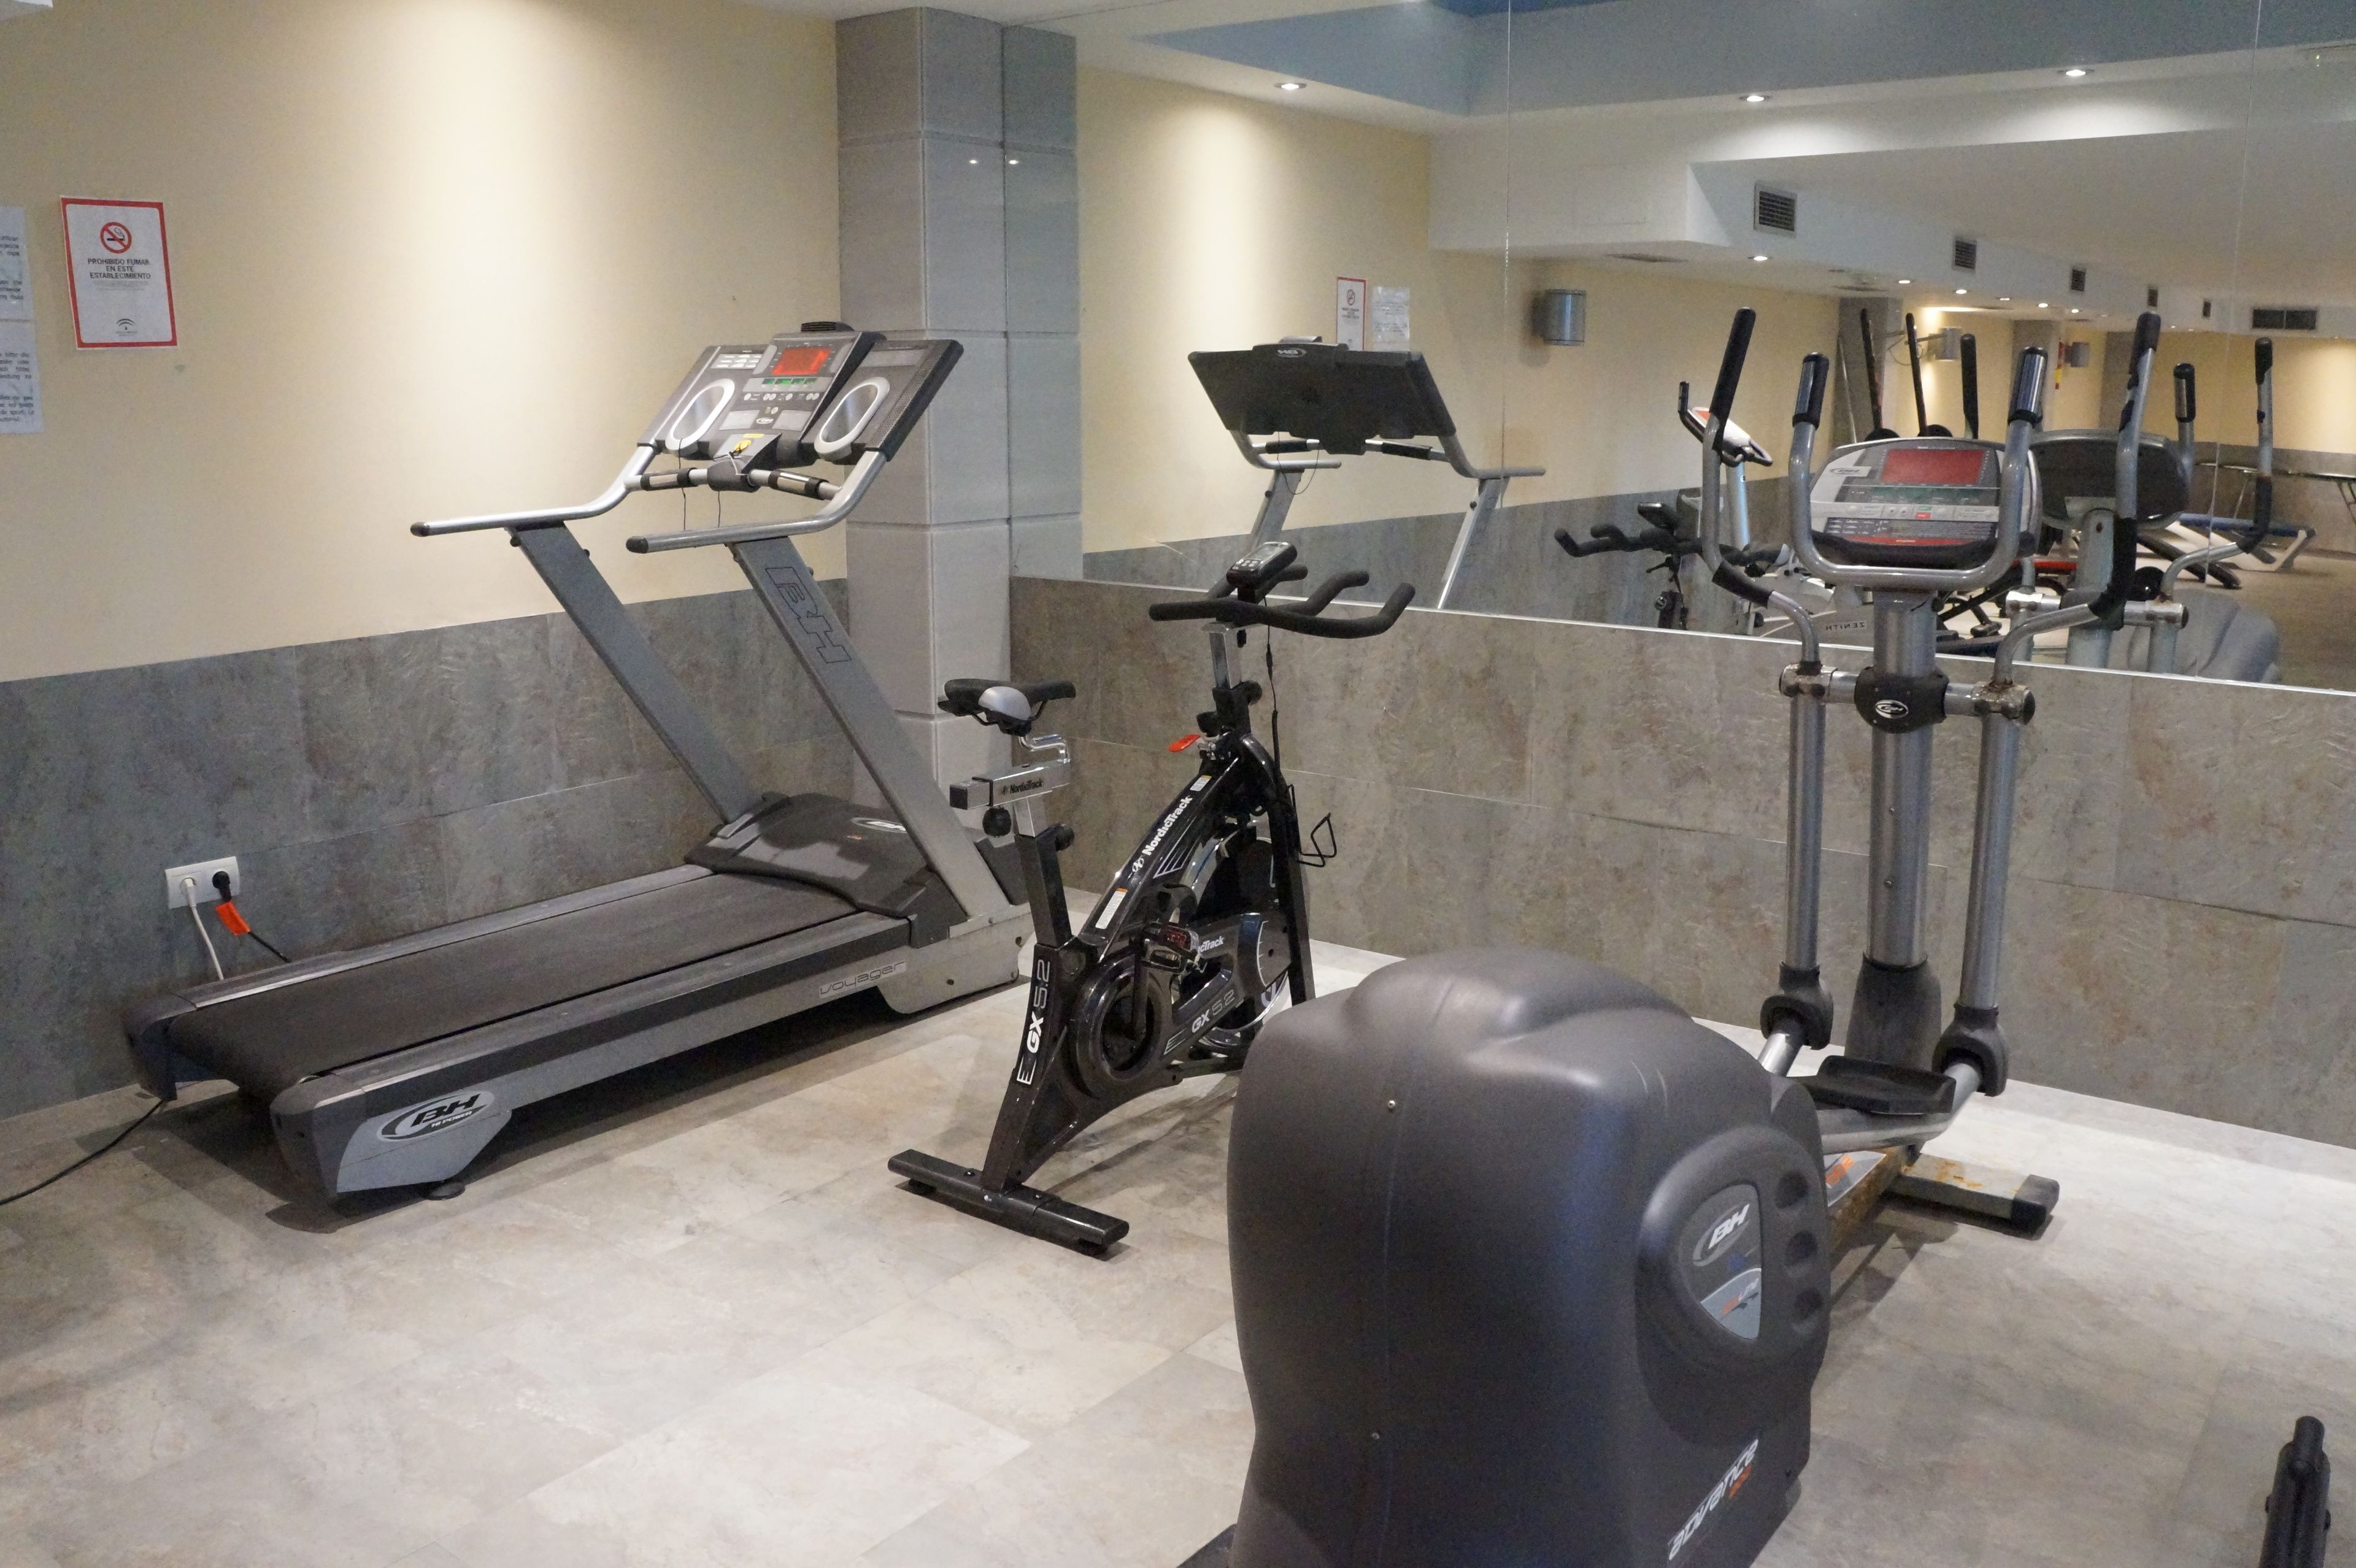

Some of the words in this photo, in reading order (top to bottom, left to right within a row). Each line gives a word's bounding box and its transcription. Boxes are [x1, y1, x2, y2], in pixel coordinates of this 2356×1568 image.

[1010, 778, 1044, 794] NordicTrack
[1142, 795, 1193, 856] NordicTrack
[820, 961, 906, 995] voyager
[1033, 959, 1051, 1009] 5.2
[1026, 1011, 1044, 1054] GX
[1191, 1009, 1211, 1033] GX
[1212, 989, 1236, 1016] 5.2
[410, 1093, 482, 1128] BH
[442, 1110, 473, 1124] POWER
[1708, 1203, 1750, 1250] BH
